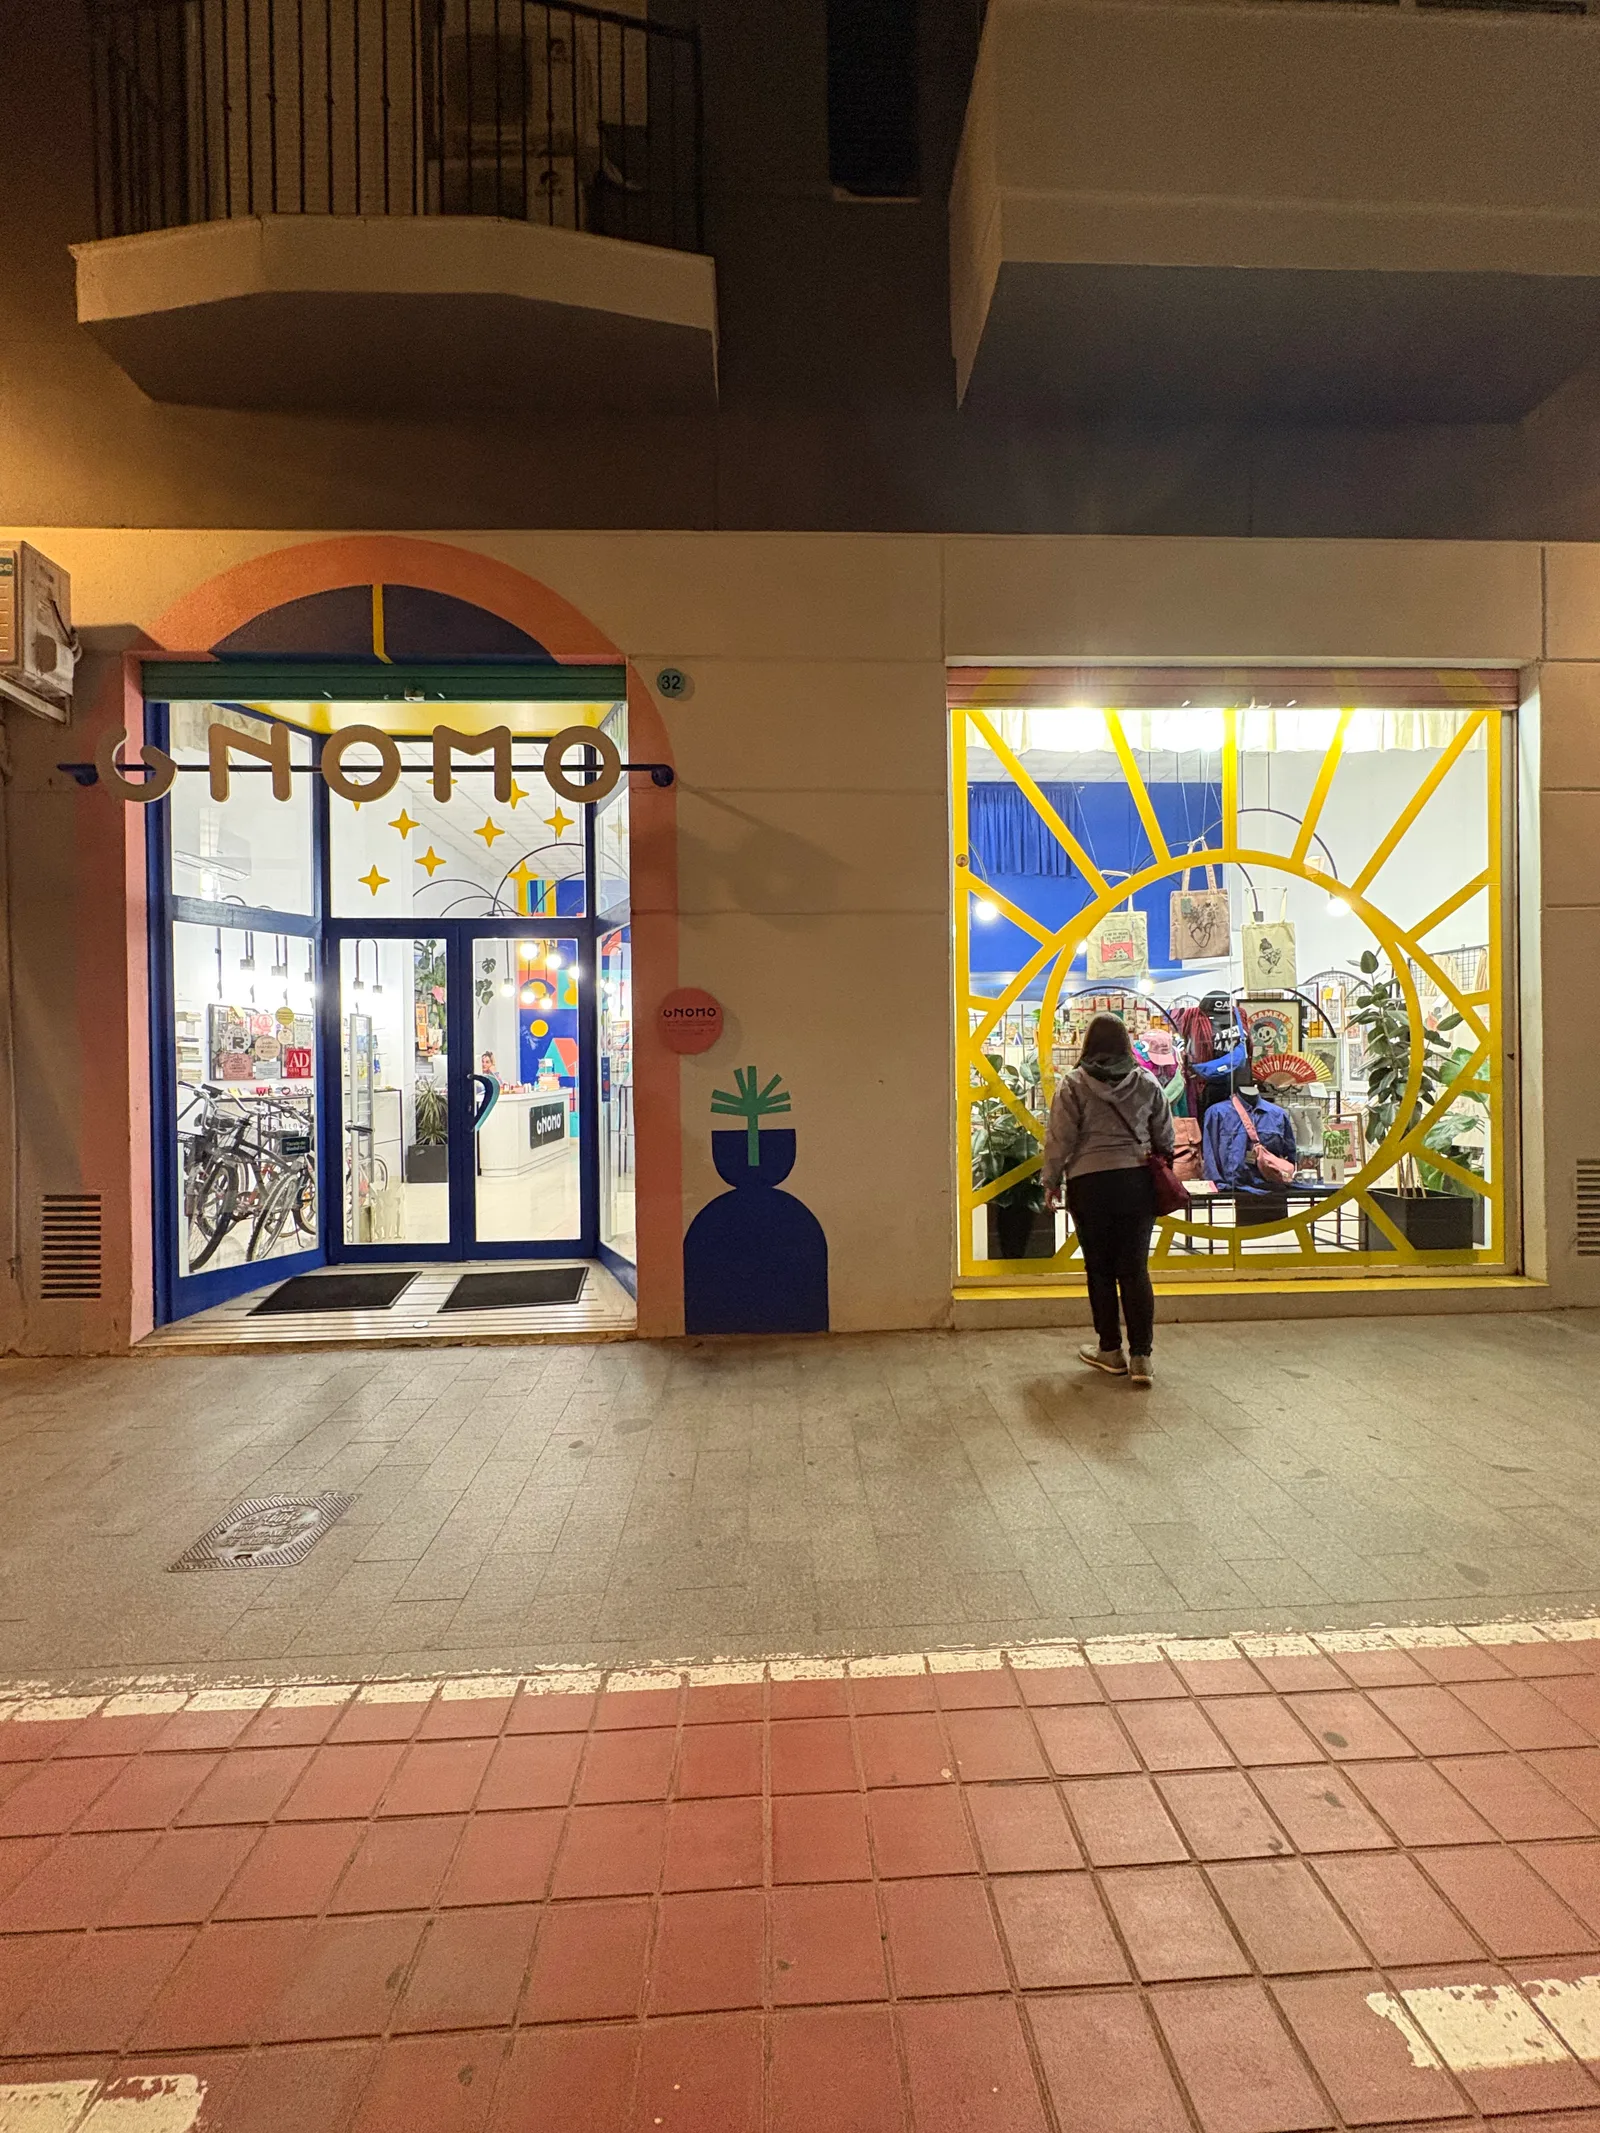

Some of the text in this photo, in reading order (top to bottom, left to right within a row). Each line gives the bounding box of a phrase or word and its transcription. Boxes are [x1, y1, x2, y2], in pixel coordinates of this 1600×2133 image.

[662, 675, 681, 690] 32
[95, 724, 621, 803] GNOMO
[663, 1007, 717, 1018] GNOMO
[1251, 1010, 1287, 1022] RAMEN
[289, 1052, 310, 1068] AD
[1256, 1060, 1280, 1077] PUTO
[536, 1113, 561, 1135] GNOMO
